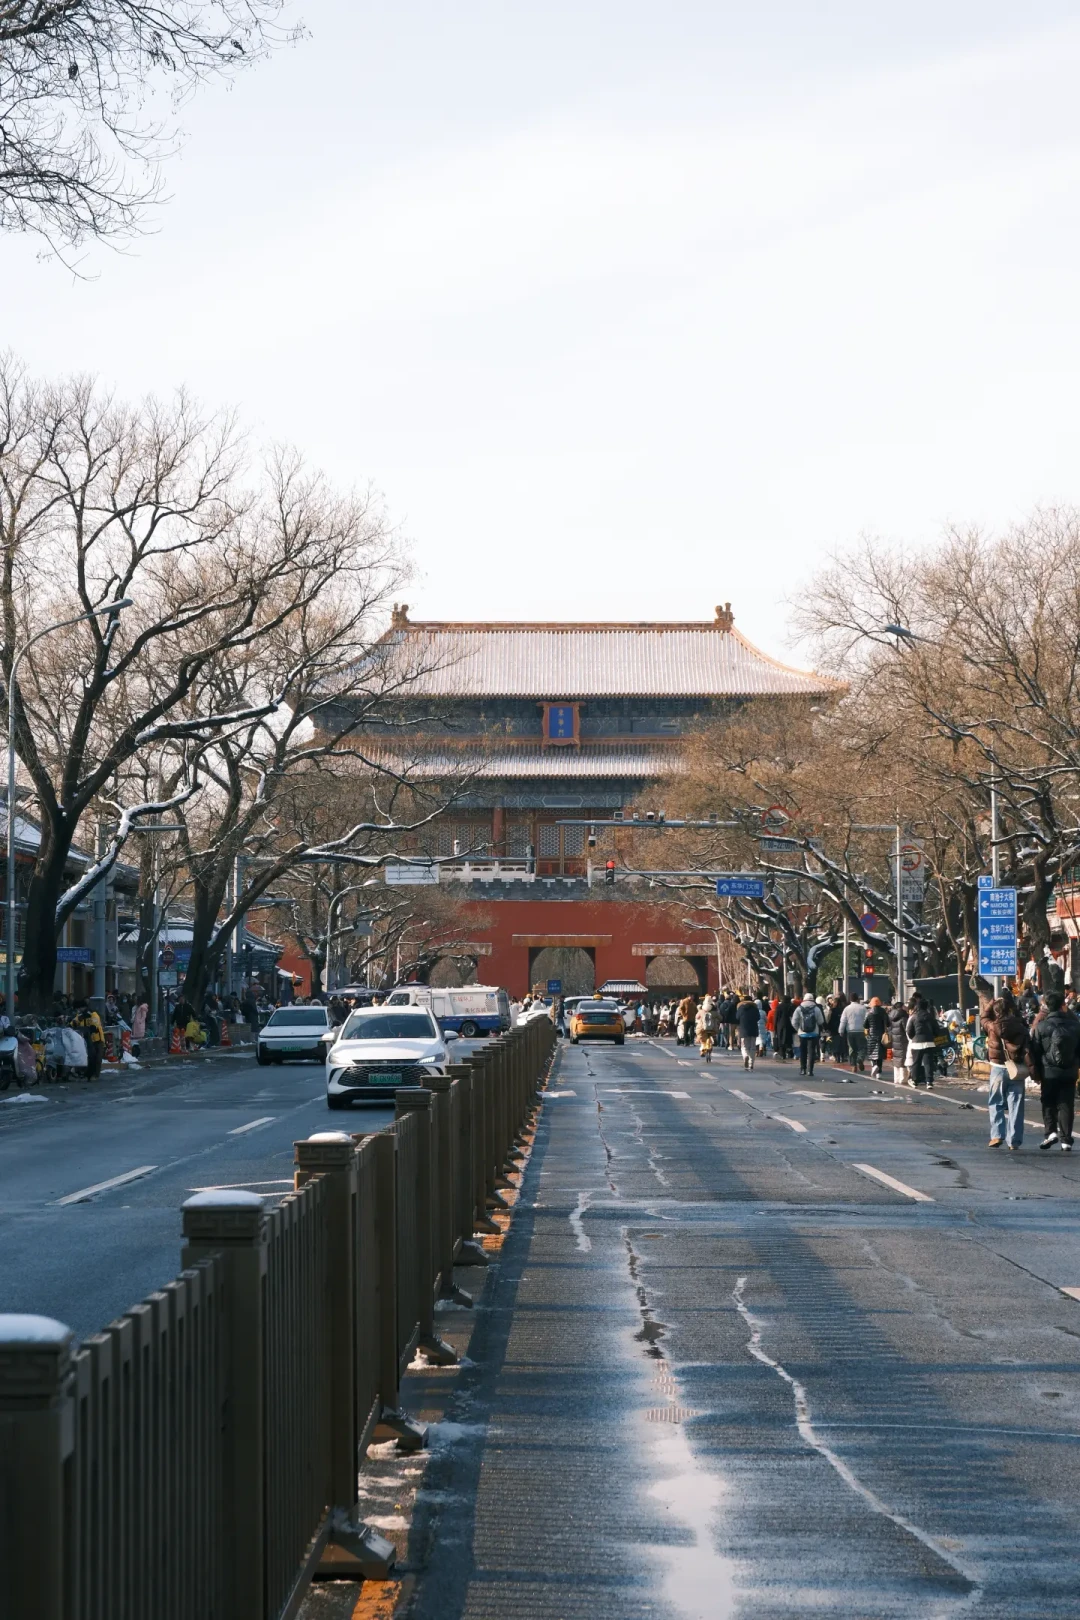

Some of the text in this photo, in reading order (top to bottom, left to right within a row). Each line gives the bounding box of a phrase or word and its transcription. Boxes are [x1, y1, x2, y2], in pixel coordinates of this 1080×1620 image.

[731, 882, 760, 890] 东华门大街
[990, 893, 1014, 902] 南池子大街
[990, 925, 1014, 934] 东华门大街
[991, 950, 1015, 959] 北池子大街
